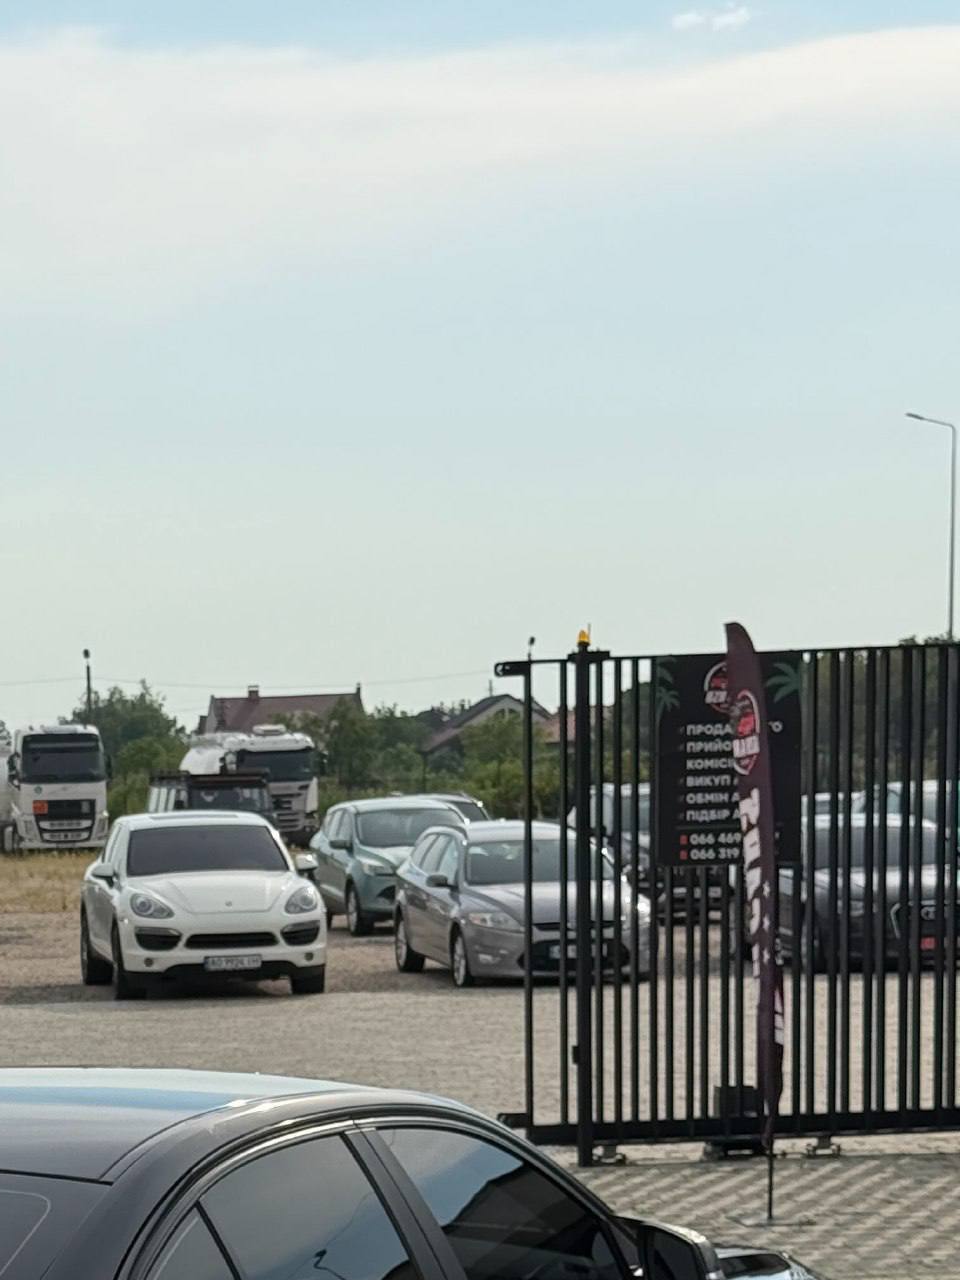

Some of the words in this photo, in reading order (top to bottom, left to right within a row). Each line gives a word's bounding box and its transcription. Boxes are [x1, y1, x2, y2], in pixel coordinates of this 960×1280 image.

[686, 724, 734, 736] ПРОДА
[686, 738, 733, 752] ПРИЙО
[686, 759, 735, 770] КОМІСІ
[686, 775, 731, 787] ВИКУП
[686, 793, 730, 804] ОБМІН
[686, 810, 730, 821] ПІДБІР
